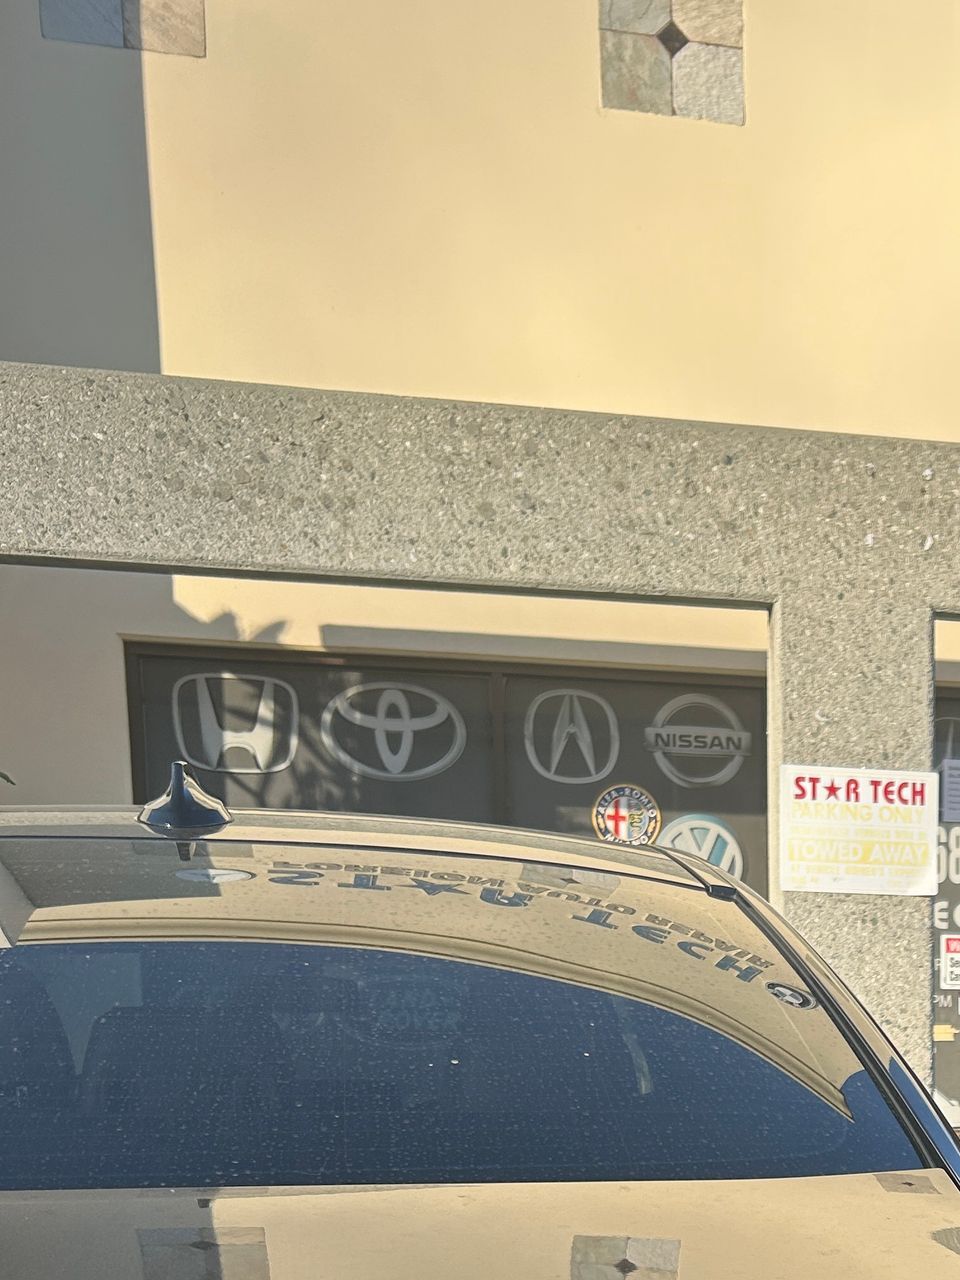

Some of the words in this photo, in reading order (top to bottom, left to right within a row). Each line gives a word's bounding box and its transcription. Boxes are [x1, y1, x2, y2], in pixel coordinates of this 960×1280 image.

[655, 733, 742, 750] NISSAN
[870, 779, 927, 806] TECH
[792, 802, 871, 822] PARKING
[791, 840, 864, 861] TOWED
[869, 843, 927, 865] AWAY
